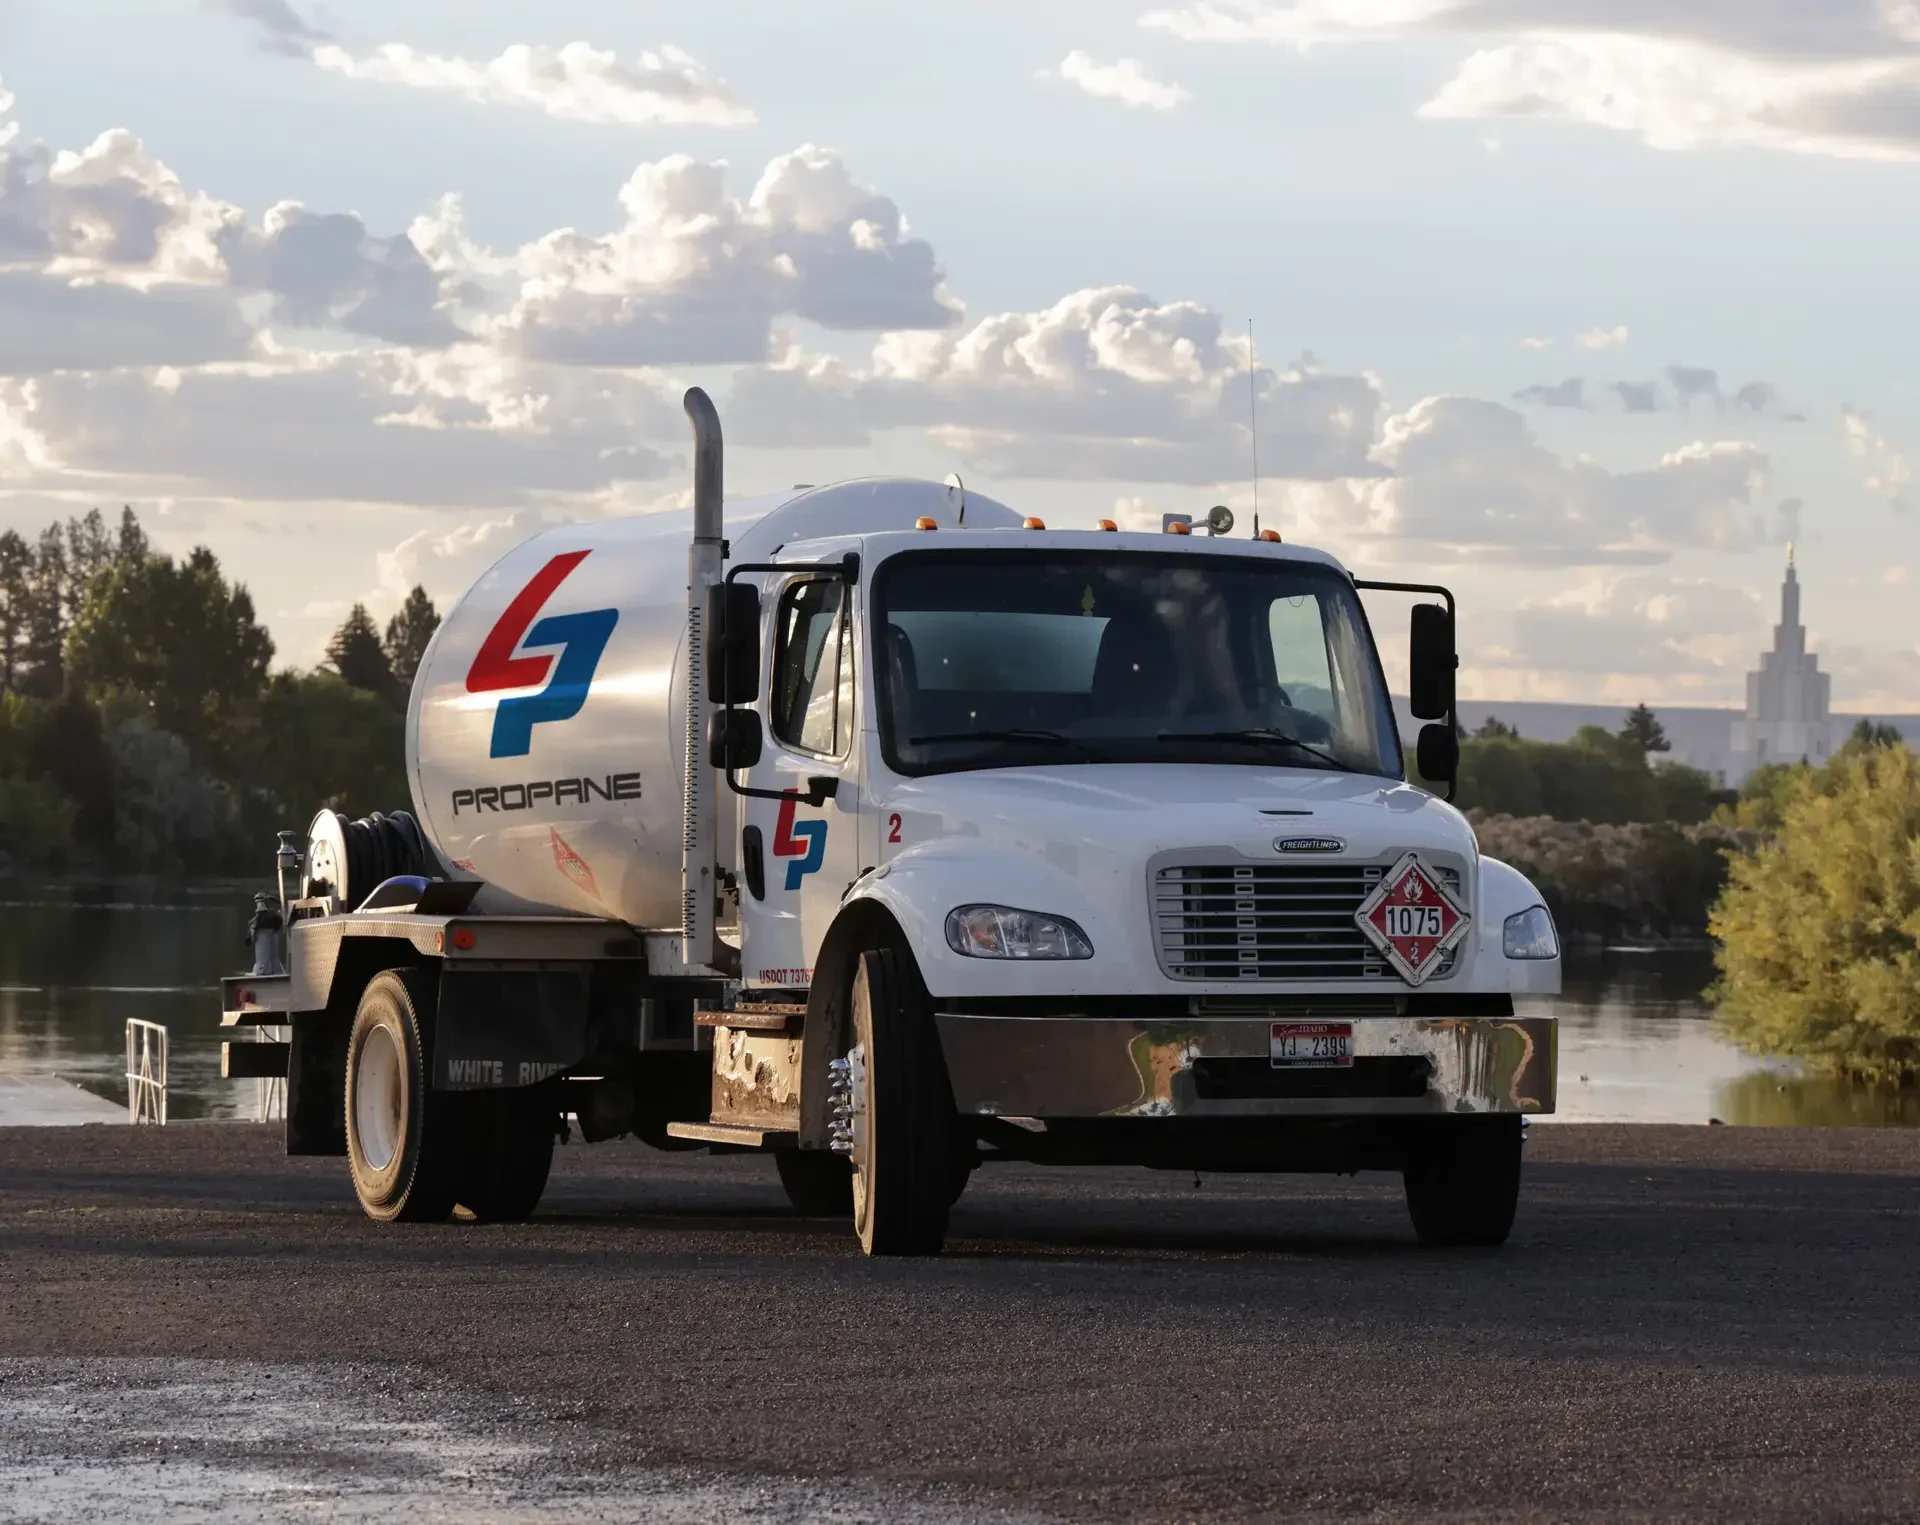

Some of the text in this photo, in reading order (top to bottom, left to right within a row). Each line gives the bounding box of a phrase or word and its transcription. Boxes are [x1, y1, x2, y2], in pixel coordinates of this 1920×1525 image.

[466, 549, 619, 758] LP
[452, 772, 642, 816] PROPANE
[888, 813, 902, 843] 2
[1282, 840, 1338, 849] FREIGHTLINER
[1387, 907, 1441, 936] 1075
[1410, 946, 1419, 960] 2
[759, 968, 788, 984] USDOT
[1299, 1025, 1328, 1033] IDAHO
[1280, 1036, 1346, 1057] YJ 2399
[447, 1059, 504, 1084] WHITE
